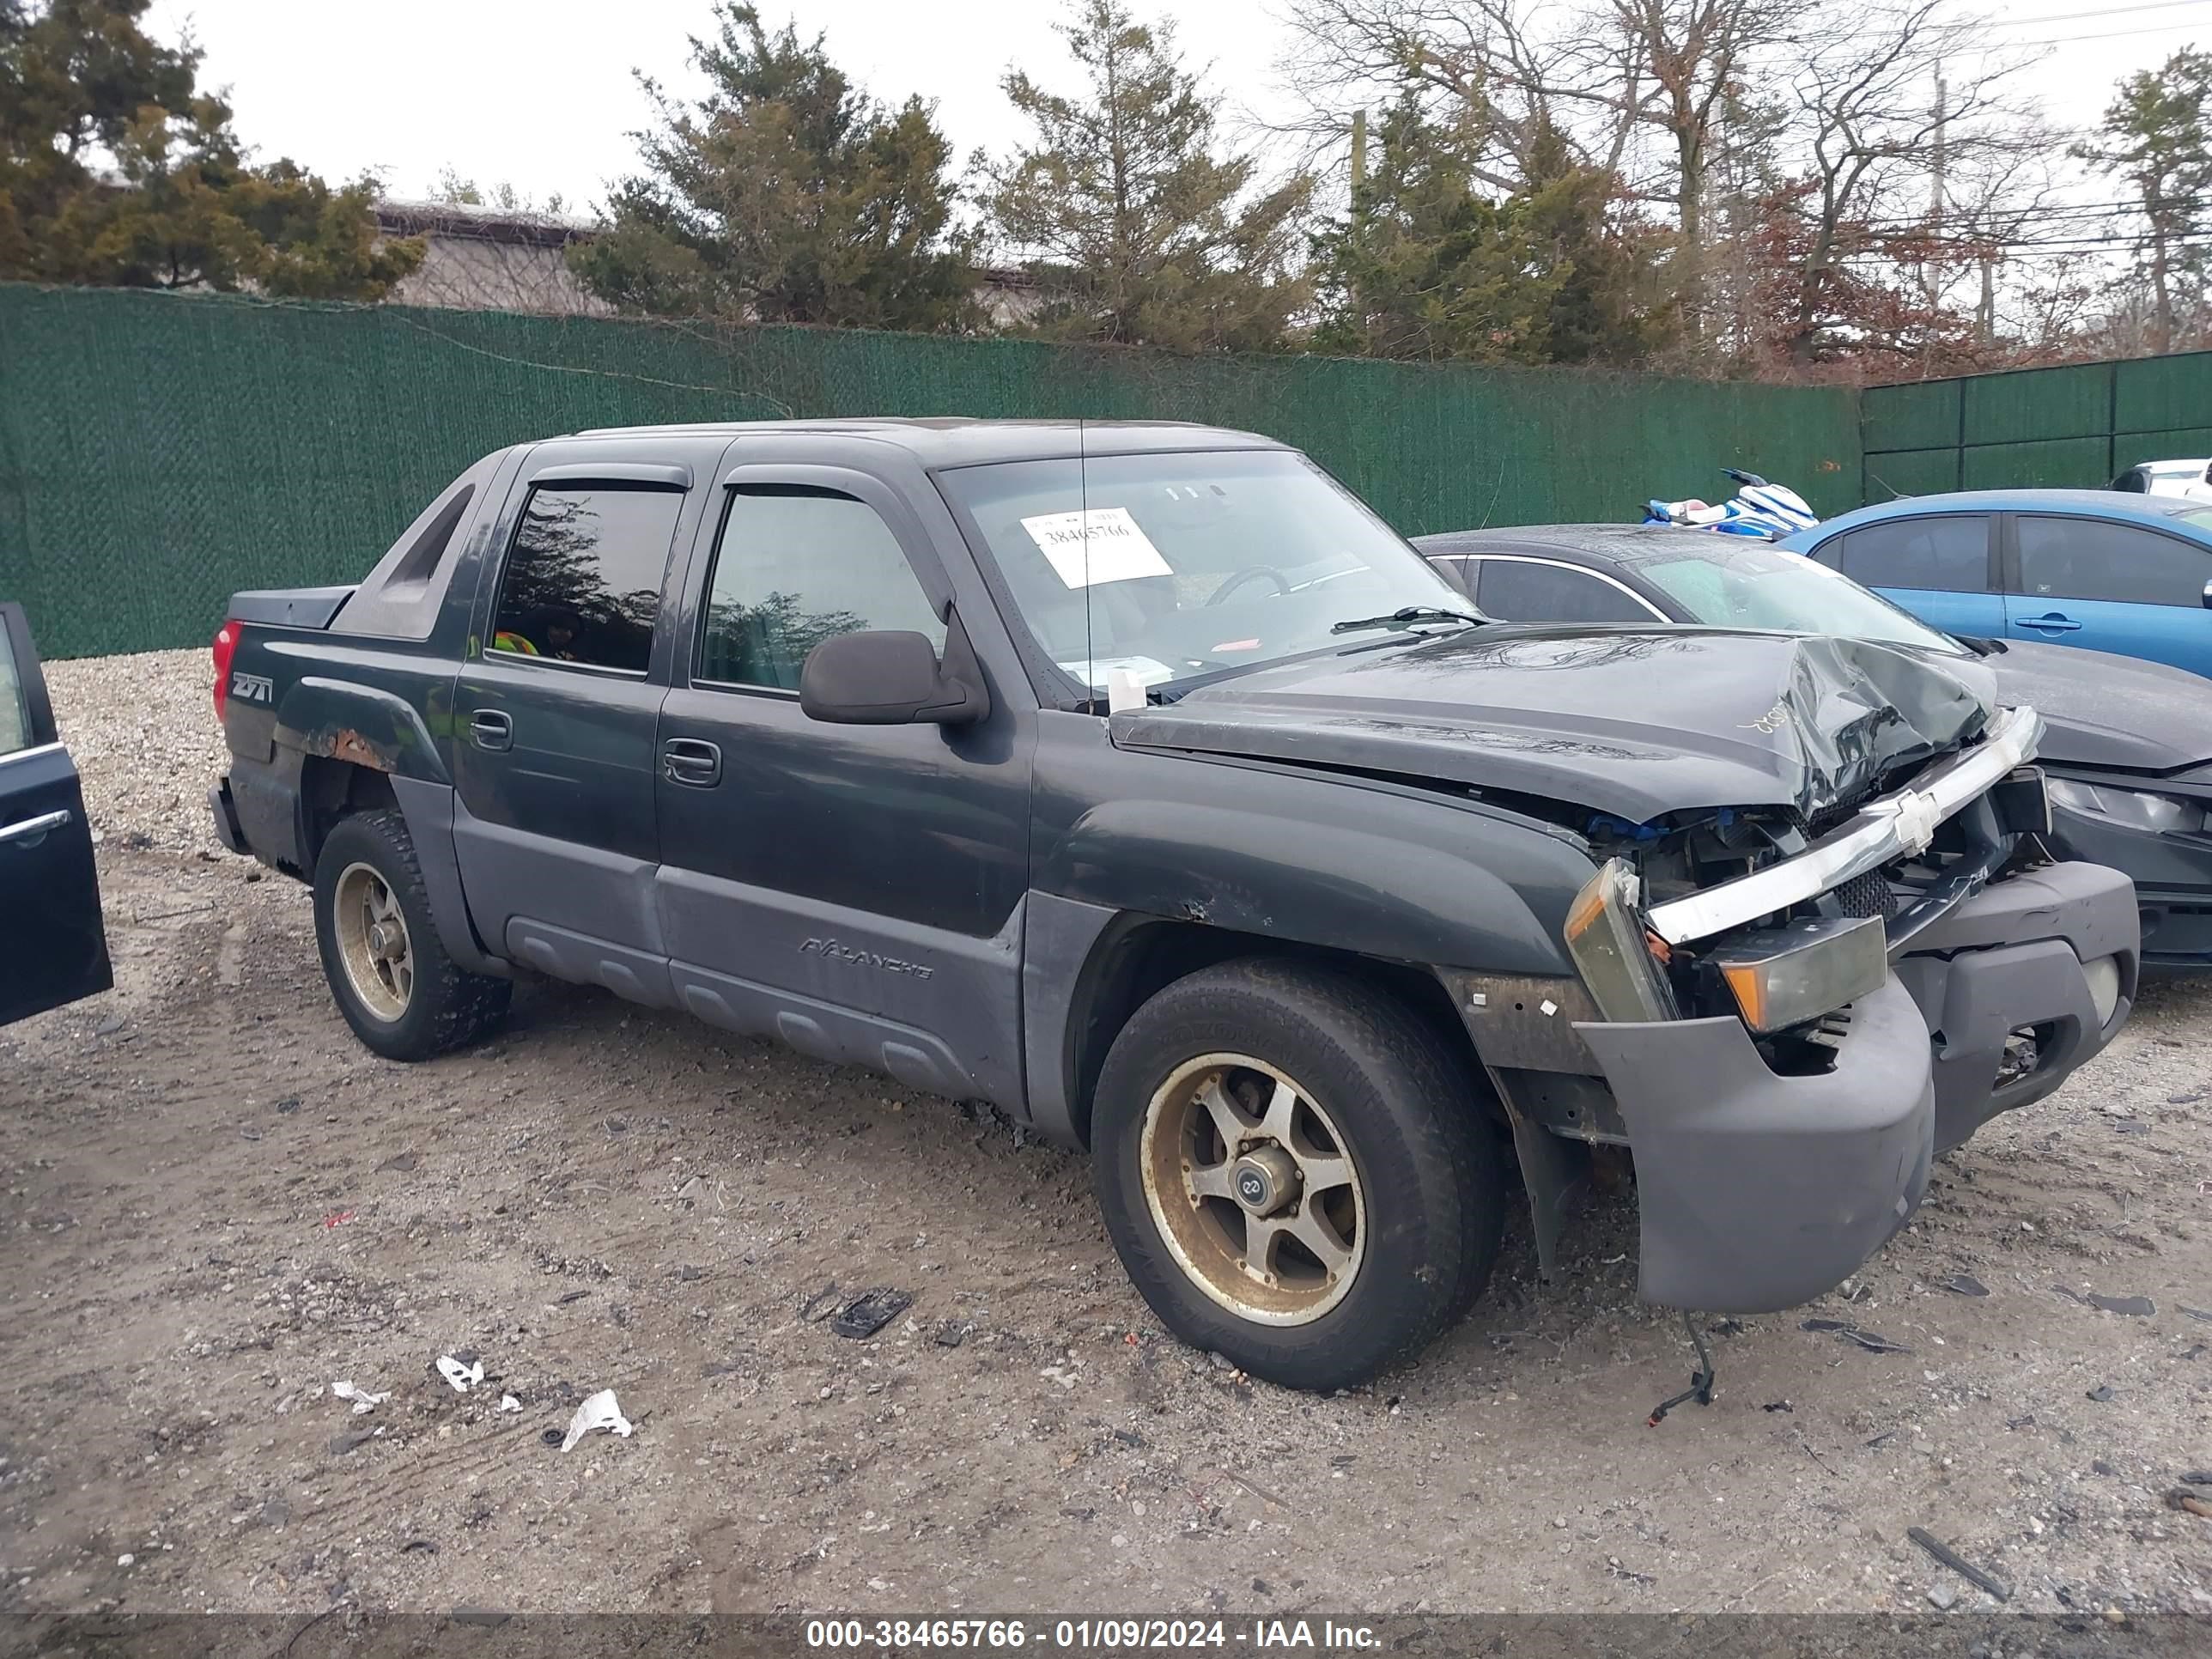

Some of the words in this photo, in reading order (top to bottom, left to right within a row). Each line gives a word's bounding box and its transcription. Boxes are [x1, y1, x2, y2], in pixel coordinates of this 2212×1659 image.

[1045, 524, 1130, 546] 38465766
[232, 671, 274, 703] Z71
[799, 937, 935, 981] AVALANCHE
